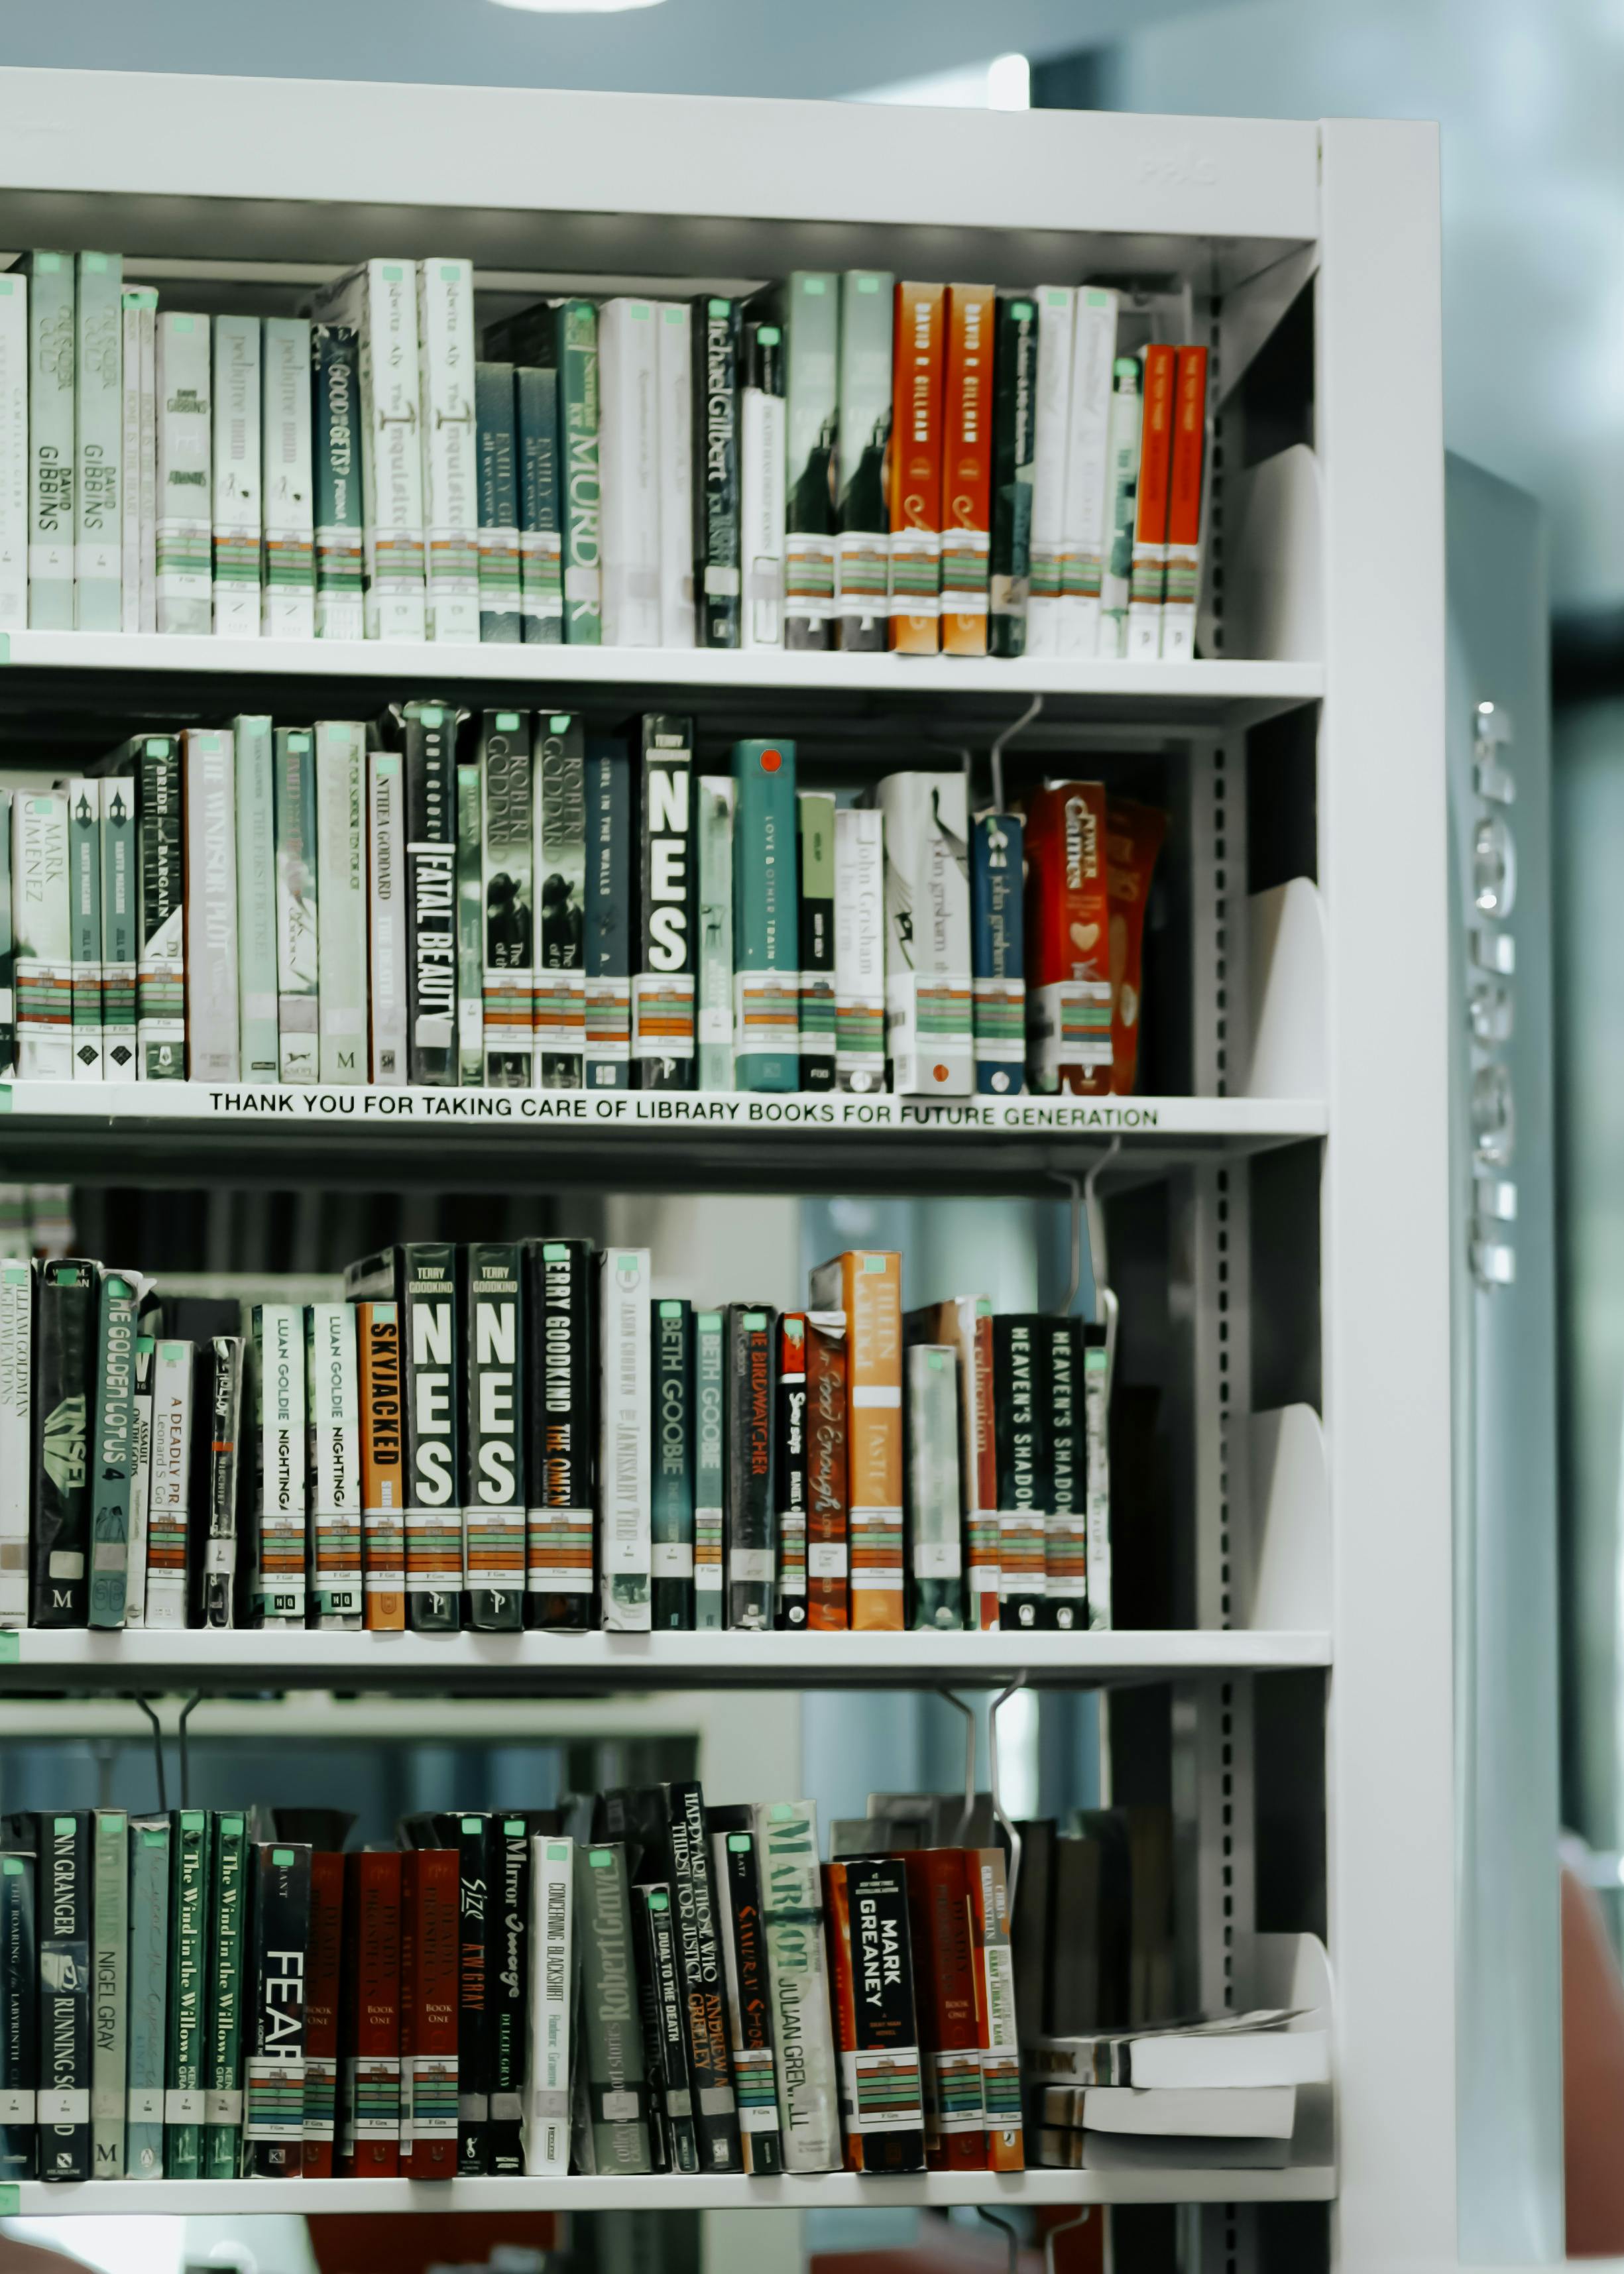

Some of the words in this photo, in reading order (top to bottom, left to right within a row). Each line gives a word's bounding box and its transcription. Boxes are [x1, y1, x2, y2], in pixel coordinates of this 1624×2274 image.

[328, 365, 351, 415] GOOD
[496, 433, 512, 493] EMILY
[708, 395, 734, 481] Gilbert
[38, 445, 60, 532] GIBBINS
[59, 467, 72, 512] DAVID
[84, 443, 103, 530] GIBBINS
[103, 466, 117, 510] DAVID
[537, 437, 552, 498] EMILY
[571, 431, 600, 622] MURDR
[156, 765, 169, 815] BRIDE
[510, 755, 529, 843] ROBERT
[542, 736, 562, 863] GODDARD
[563, 756, 582, 844] ROBERT
[599, 758, 611, 791] GIRL
[376, 776, 390, 827] NTHEA
[487, 735, 509, 866] GODDARD
[599, 794, 610, 810] IN
[23, 801, 43, 903] GIMENEZ
[44, 823, 64, 884] MARK
[203, 790, 228, 895] WINDSOR
[599, 815, 610, 843] THE
[764, 815, 775, 851] LOVE
[156, 845, 171, 918] BARGAIN
[376, 830, 391, 901] GODDARD
[599, 848, 610, 896] WALLS
[855, 837, 877, 887] John
[929, 838, 954, 878] john
[416, 855, 452, 924] FATAL
[764, 868, 775, 913] OTHER
[990, 874, 1010, 911] john
[203, 900, 228, 952] PLOT
[764, 919, 776, 960] TRAIN
[858, 891, 879, 976] Grisham
[928, 881, 955, 952] grisham
[494, 942, 507, 957] of
[509, 942, 524, 968] The
[549, 943, 561, 957] of
[563, 944, 577, 968] The
[988, 913, 1011, 979] grisham
[416, 932, 454, 1030] BEAUTY
[337, 1051, 355, 1068] M
[209, 1092, 294, 1113] THANK
[303, 1094, 355, 1114] YOU
[365, 1096, 414, 1115] FOR
[422, 1097, 512, 1117] TAKING
[521, 1098, 587, 1117] CARE
[596, 1100, 628, 1119] OF
[637, 1100, 740, 1120] LIBRARY
[749, 1103, 834, 1123] BOOKS
[844, 1105, 891, 1124] FOR
[900, 1106, 995, 1125] FUTURE
[1004, 1107, 1158, 1127] GENERATION
[408, 1280, 453, 1294] GOODKIND
[473, 1280, 518, 1294] GOODKIND
[277, 1318, 289, 1359] LUAN
[330, 1316, 342, 1357] LUAN
[620, 1301, 636, 1337] JASON
[662, 1317, 683, 1371] BETH
[0, 1328, 15, 1406] WEAPONS
[16, 1341, 29, 1418] GOLDMAN
[105, 1326, 131, 1398] GOLDEN
[545, 1315, 571, 1412] GOODKIND
[620, 1342, 636, 1396] GOODWIN
[701, 1334, 720, 1381] BETH
[1011, 1327, 1031, 1424] HEAVEN'S
[1053, 1332, 1072, 1427] HEAVEN'S
[169, 1396, 182, 1408] A
[215, 1373, 233, 1417] HOLLOW
[277, 1363, 289, 1421] GOLDIE
[331, 1361, 343, 1418] GOLDIE
[371, 1324, 398, 1465] SKYJACKED
[752, 1351, 768, 1475] BIRDWATCHER
[819, 1371, 842, 1422] Good
[102, 1402, 128, 1463] LOTUS
[140, 1420, 148, 1465] ASSAULT
[155, 1414, 168, 1467] Leonard
[168, 1413, 182, 1477] DEADLY
[546, 1424, 571, 1453] THE
[662, 1379, 683, 1475] GOOBIE
[701, 1387, 721, 1469] GOOBIE
[102, 1467, 125, 1481] 4
[217, 1456, 228, 1507] MISCHIEF
[546, 1458, 571, 1507] OMEN
[616, 1423, 641, 1503] JANISSARY
[809, 1427, 844, 1512] Enough
[52, 1589, 72, 1609] M
[683, 1792, 704, 1847] HAPPY
[181, 1850, 199, 1884] The
[219, 1852, 237, 1885] The
[504, 1837, 526, 1907] Mirror
[669, 1822, 689, 1877] THIRST
[689, 1849, 708, 1883] ARE
[11, 1881, 21, 1905] THE
[54, 1859, 76, 1935] GRANGER
[180, 1888, 199, 1937] Wind
[218, 1888, 237, 1937] Wind
[460, 1877, 487, 1921] Size
[546, 1882, 567, 1941] CONCERNING
[677, 1882, 694, 1919] FOR
[693, 1887, 713, 1938] THOSE
[11, 1909, 21, 1963] ROARING
[180, 1939, 198, 1957] in
[218, 1939, 235, 1957] in
[499, 1913, 524, 1999] Image
[658, 1931, 673, 1962] DUAL
[681, 1921, 701, 1984] JUSTICE
[737, 1905, 759, 1991] SAMURAI
[860, 1899, 882, 2008] GREANEY
[880, 1919, 901, 1984] MARK
[97, 1951, 116, 2003] NIGEL
[180, 1959, 198, 1989] the
[217, 1959, 236, 1989] the
[545, 1945, 565, 2002] BLACKSHIRT
[597, 1937, 630, 2021] Robert
[661, 1963, 674, 1978] TO
[699, 1941, 719, 1983] WHO
[367, 2004, 396, 2014] BOOK
[425, 2003, 453, 2013] BOOK
[461, 1972, 485, 2011] GRAY
[663, 1979, 676, 2002] THE
[778, 1976, 799, 2040] JULIAN
[11, 1992, 21, 2061] LABYRINTH
[53, 1997, 75, 2072] RUNNING
[97, 2005, 116, 2052] GRAY
[178, 1992, 198, 2063] Willows
[215, 1992, 235, 2063] Willows
[500, 2014, 511, 2055] DULCIE
[547, 2014, 562, 2048] Roderic
[605, 2023, 625, 2068] stories
[665, 2004, 680, 2042] DEATH
[689, 1993, 712, 2069] GREELEY
[705, 1993, 727, 2074] ANDREW
[546, 2051, 561, 2086] Graeme
[97, 2143, 118, 2163] M
